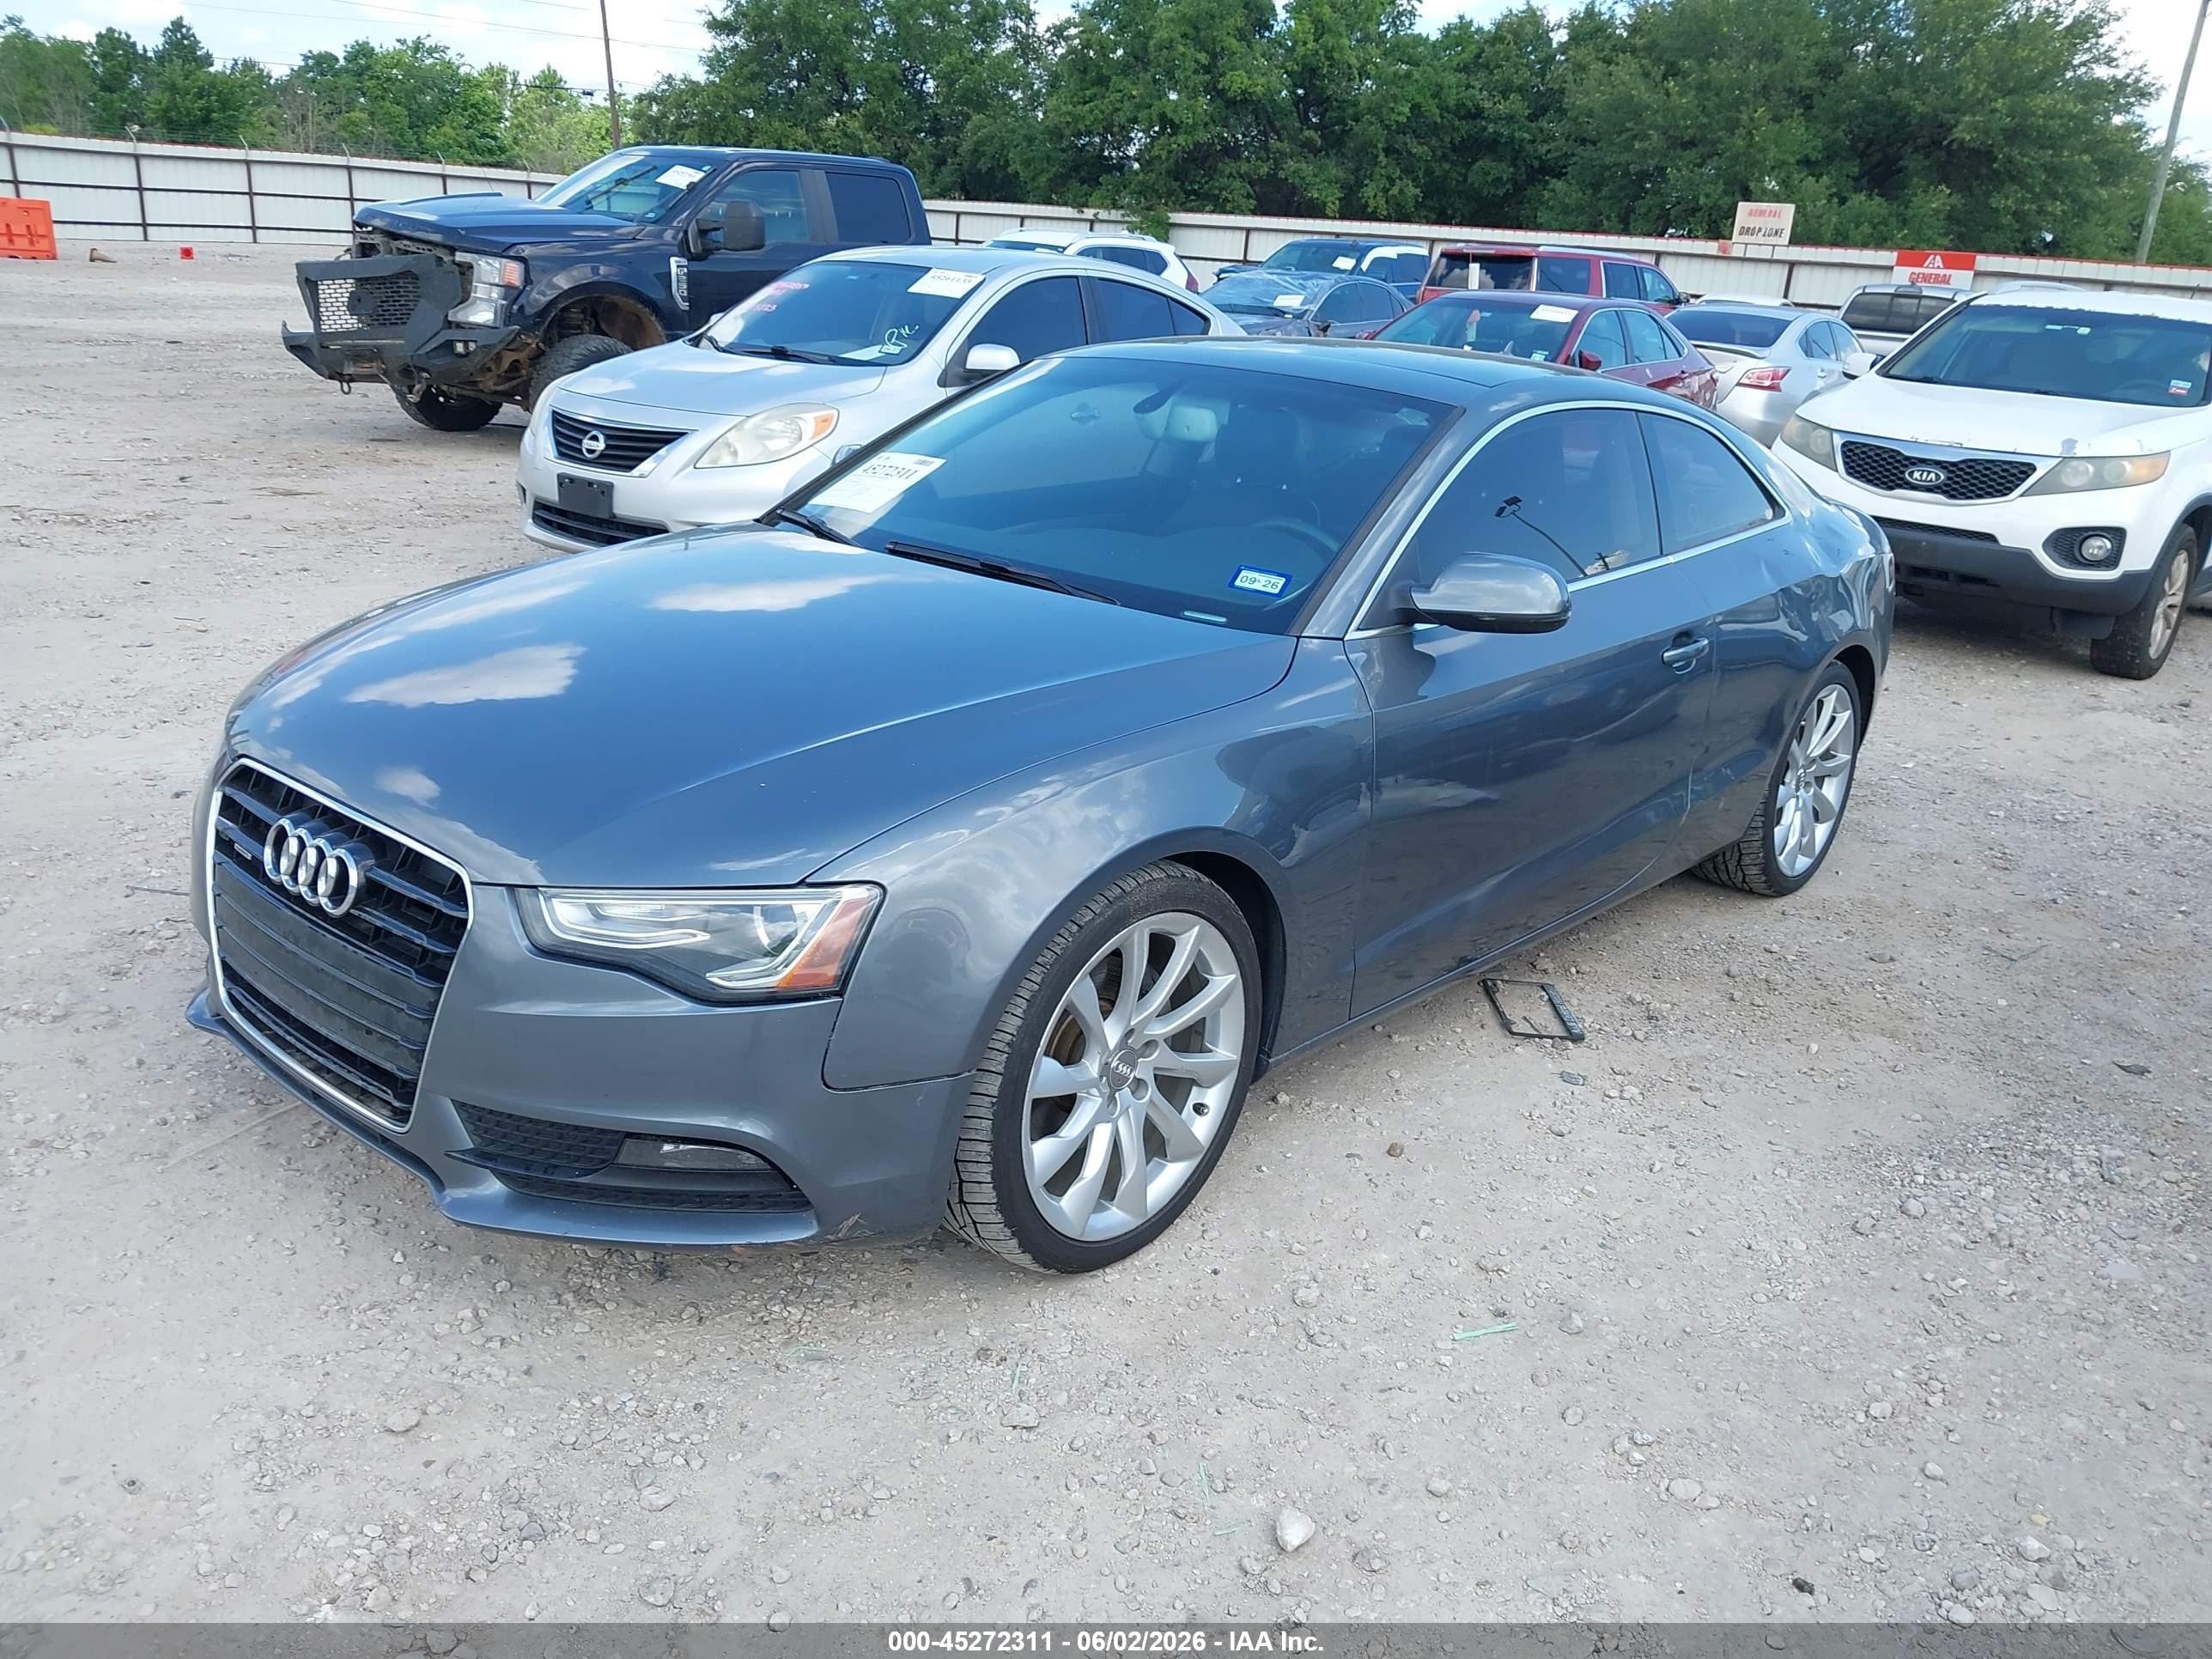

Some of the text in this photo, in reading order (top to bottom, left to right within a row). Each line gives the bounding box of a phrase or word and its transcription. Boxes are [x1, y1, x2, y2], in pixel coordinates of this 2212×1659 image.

[1738, 226, 1784, 239] DROP ZONE
[1908, 271, 1952, 285] GENERAL
[1912, 470, 1936, 482] KIA
[1239, 575, 1280, 590] 09 26
